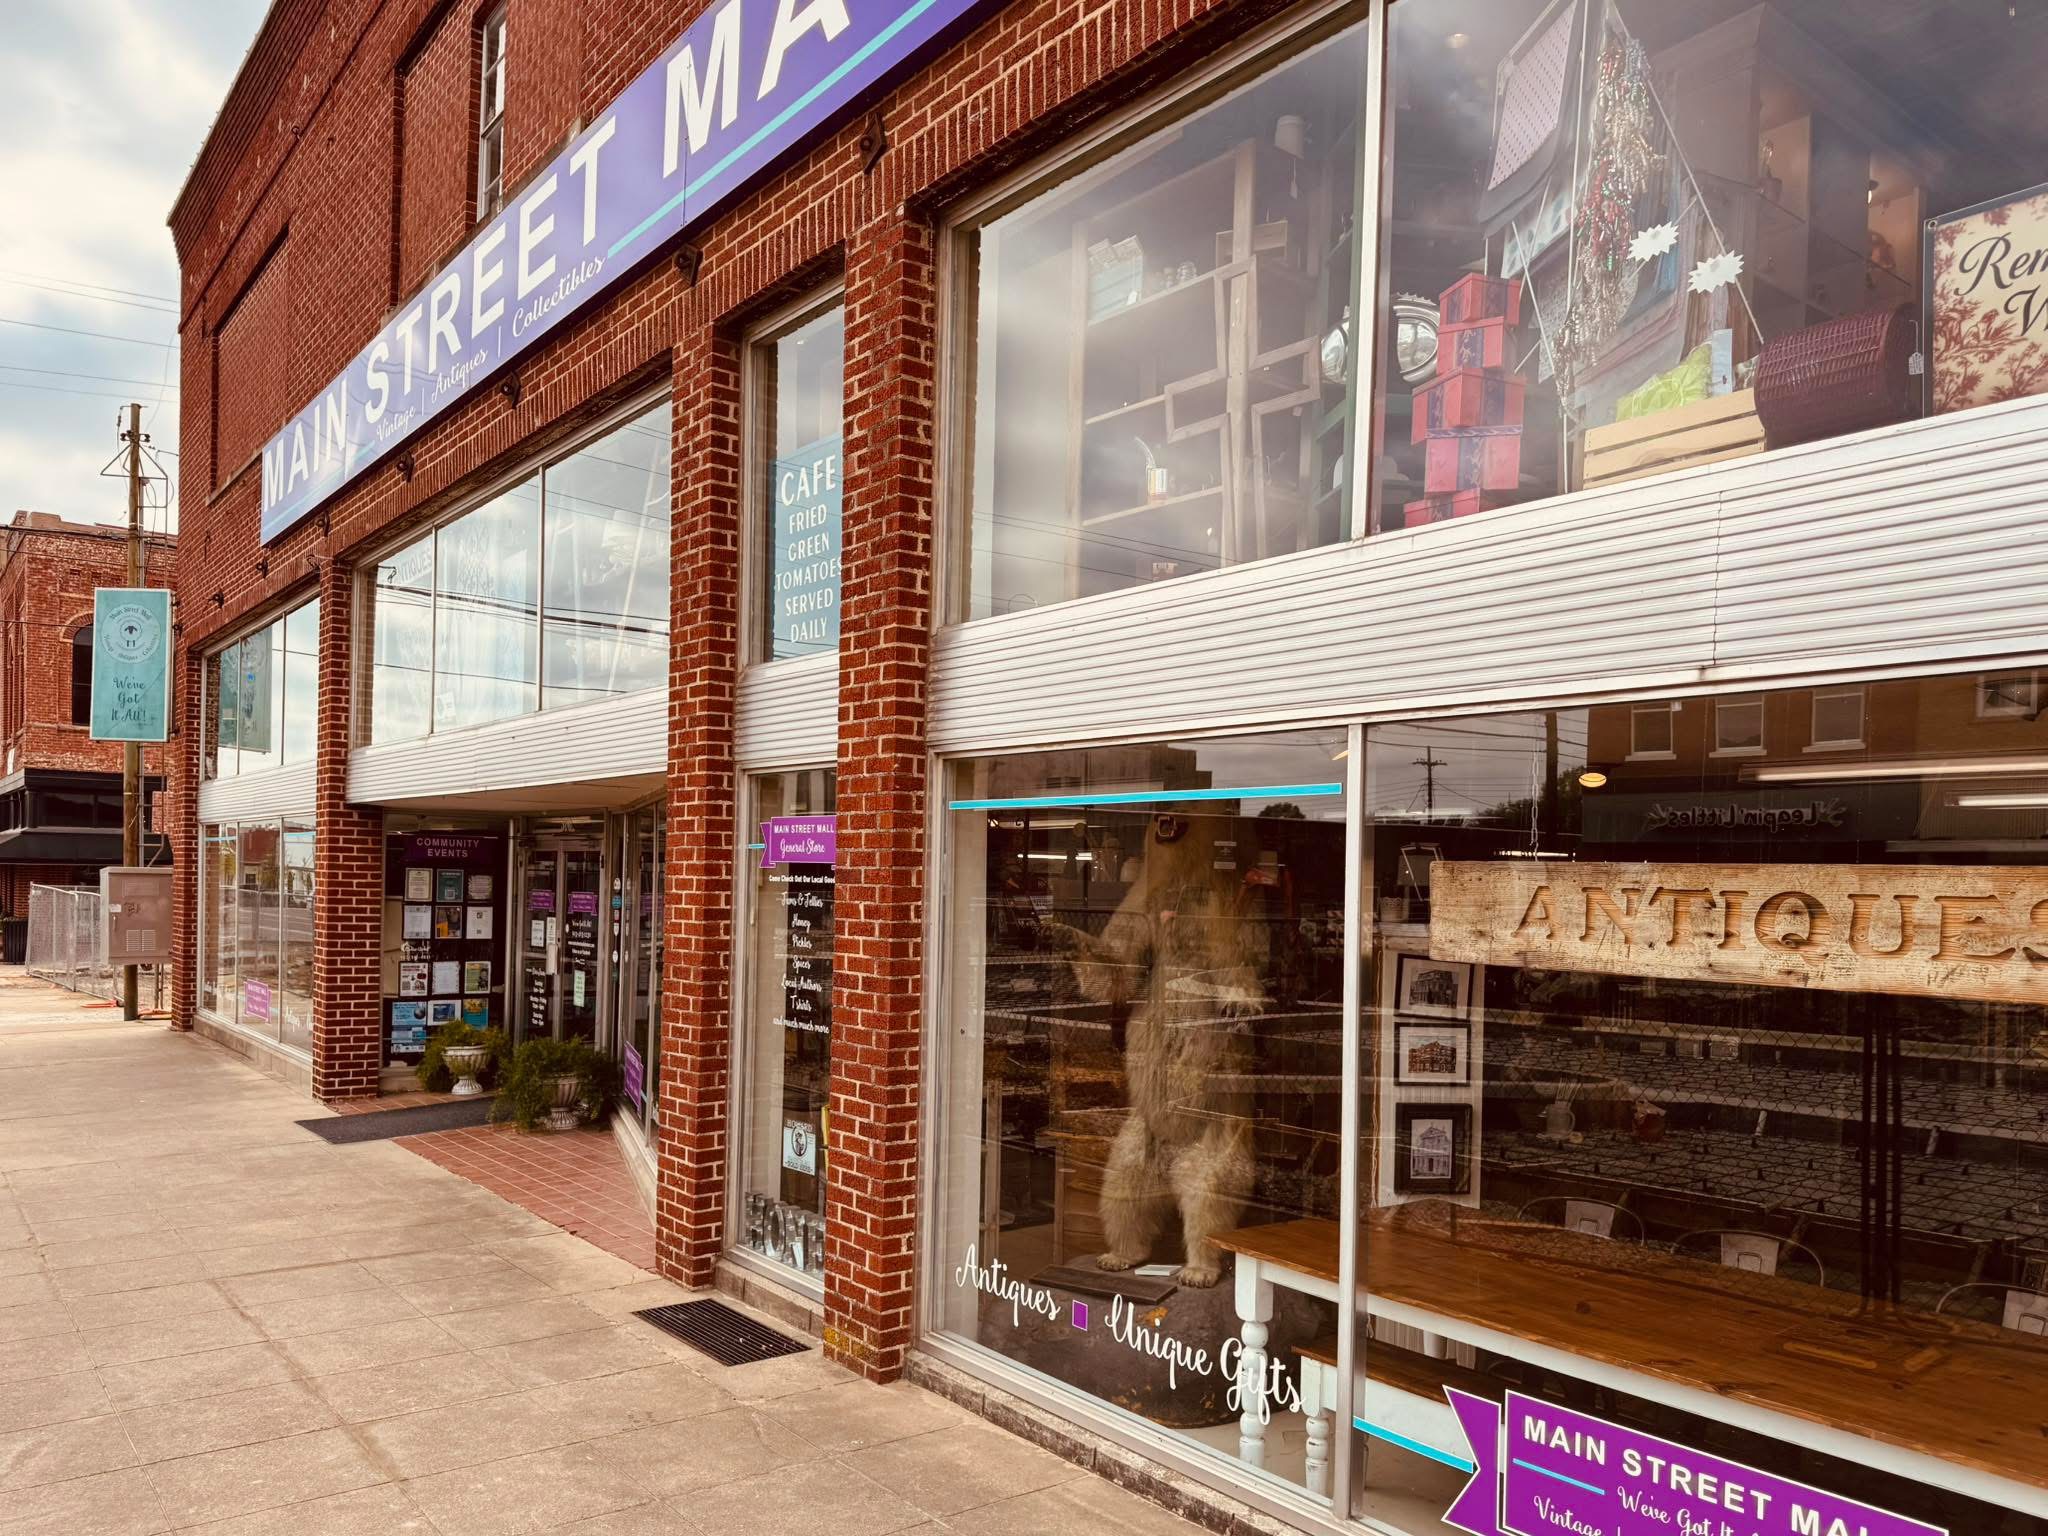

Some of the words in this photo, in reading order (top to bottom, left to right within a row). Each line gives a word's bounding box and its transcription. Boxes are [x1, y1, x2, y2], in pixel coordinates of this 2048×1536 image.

[263, 378, 348, 513] MAIN
[365, 115, 616, 424] STREET
[377, 405, 416, 441] Vintage
[431, 348, 488, 404] Antiques
[512, 256, 607, 338] Collectibles
[780, 454, 836, 507] CAFE
[788, 503, 827, 534] FRIED
[787, 532, 830, 562] GREEN
[785, 588, 833, 617] SERVED
[790, 617, 827, 643] DAILY
[112, 676, 145, 690] We've
[117, 691, 140, 709] Got
[111, 708, 119, 721] It
[774, 825, 790, 834] MAIN
[791, 825, 816, 833] STREET
[817, 824, 835, 833] MALL
[416, 837, 480, 848] COMMUNITY
[427, 848, 469, 858] EVENTS
[780, 838, 805, 859] General
[806, 838, 825, 855] Store
[791, 913, 811, 934] Honey
[792, 955, 811, 974] Spices
[814, 1024, 829, 1034] more
[955, 1242, 1060, 1328] Antiques
[1104, 1293, 1213, 1391] Unique
[1219, 1337, 1305, 1427] Gifts
[1524, 1414, 1606, 1466] MAIN
[1622, 1448, 1772, 1520] STREET
[1617, 1485, 1671, 1524] We've
